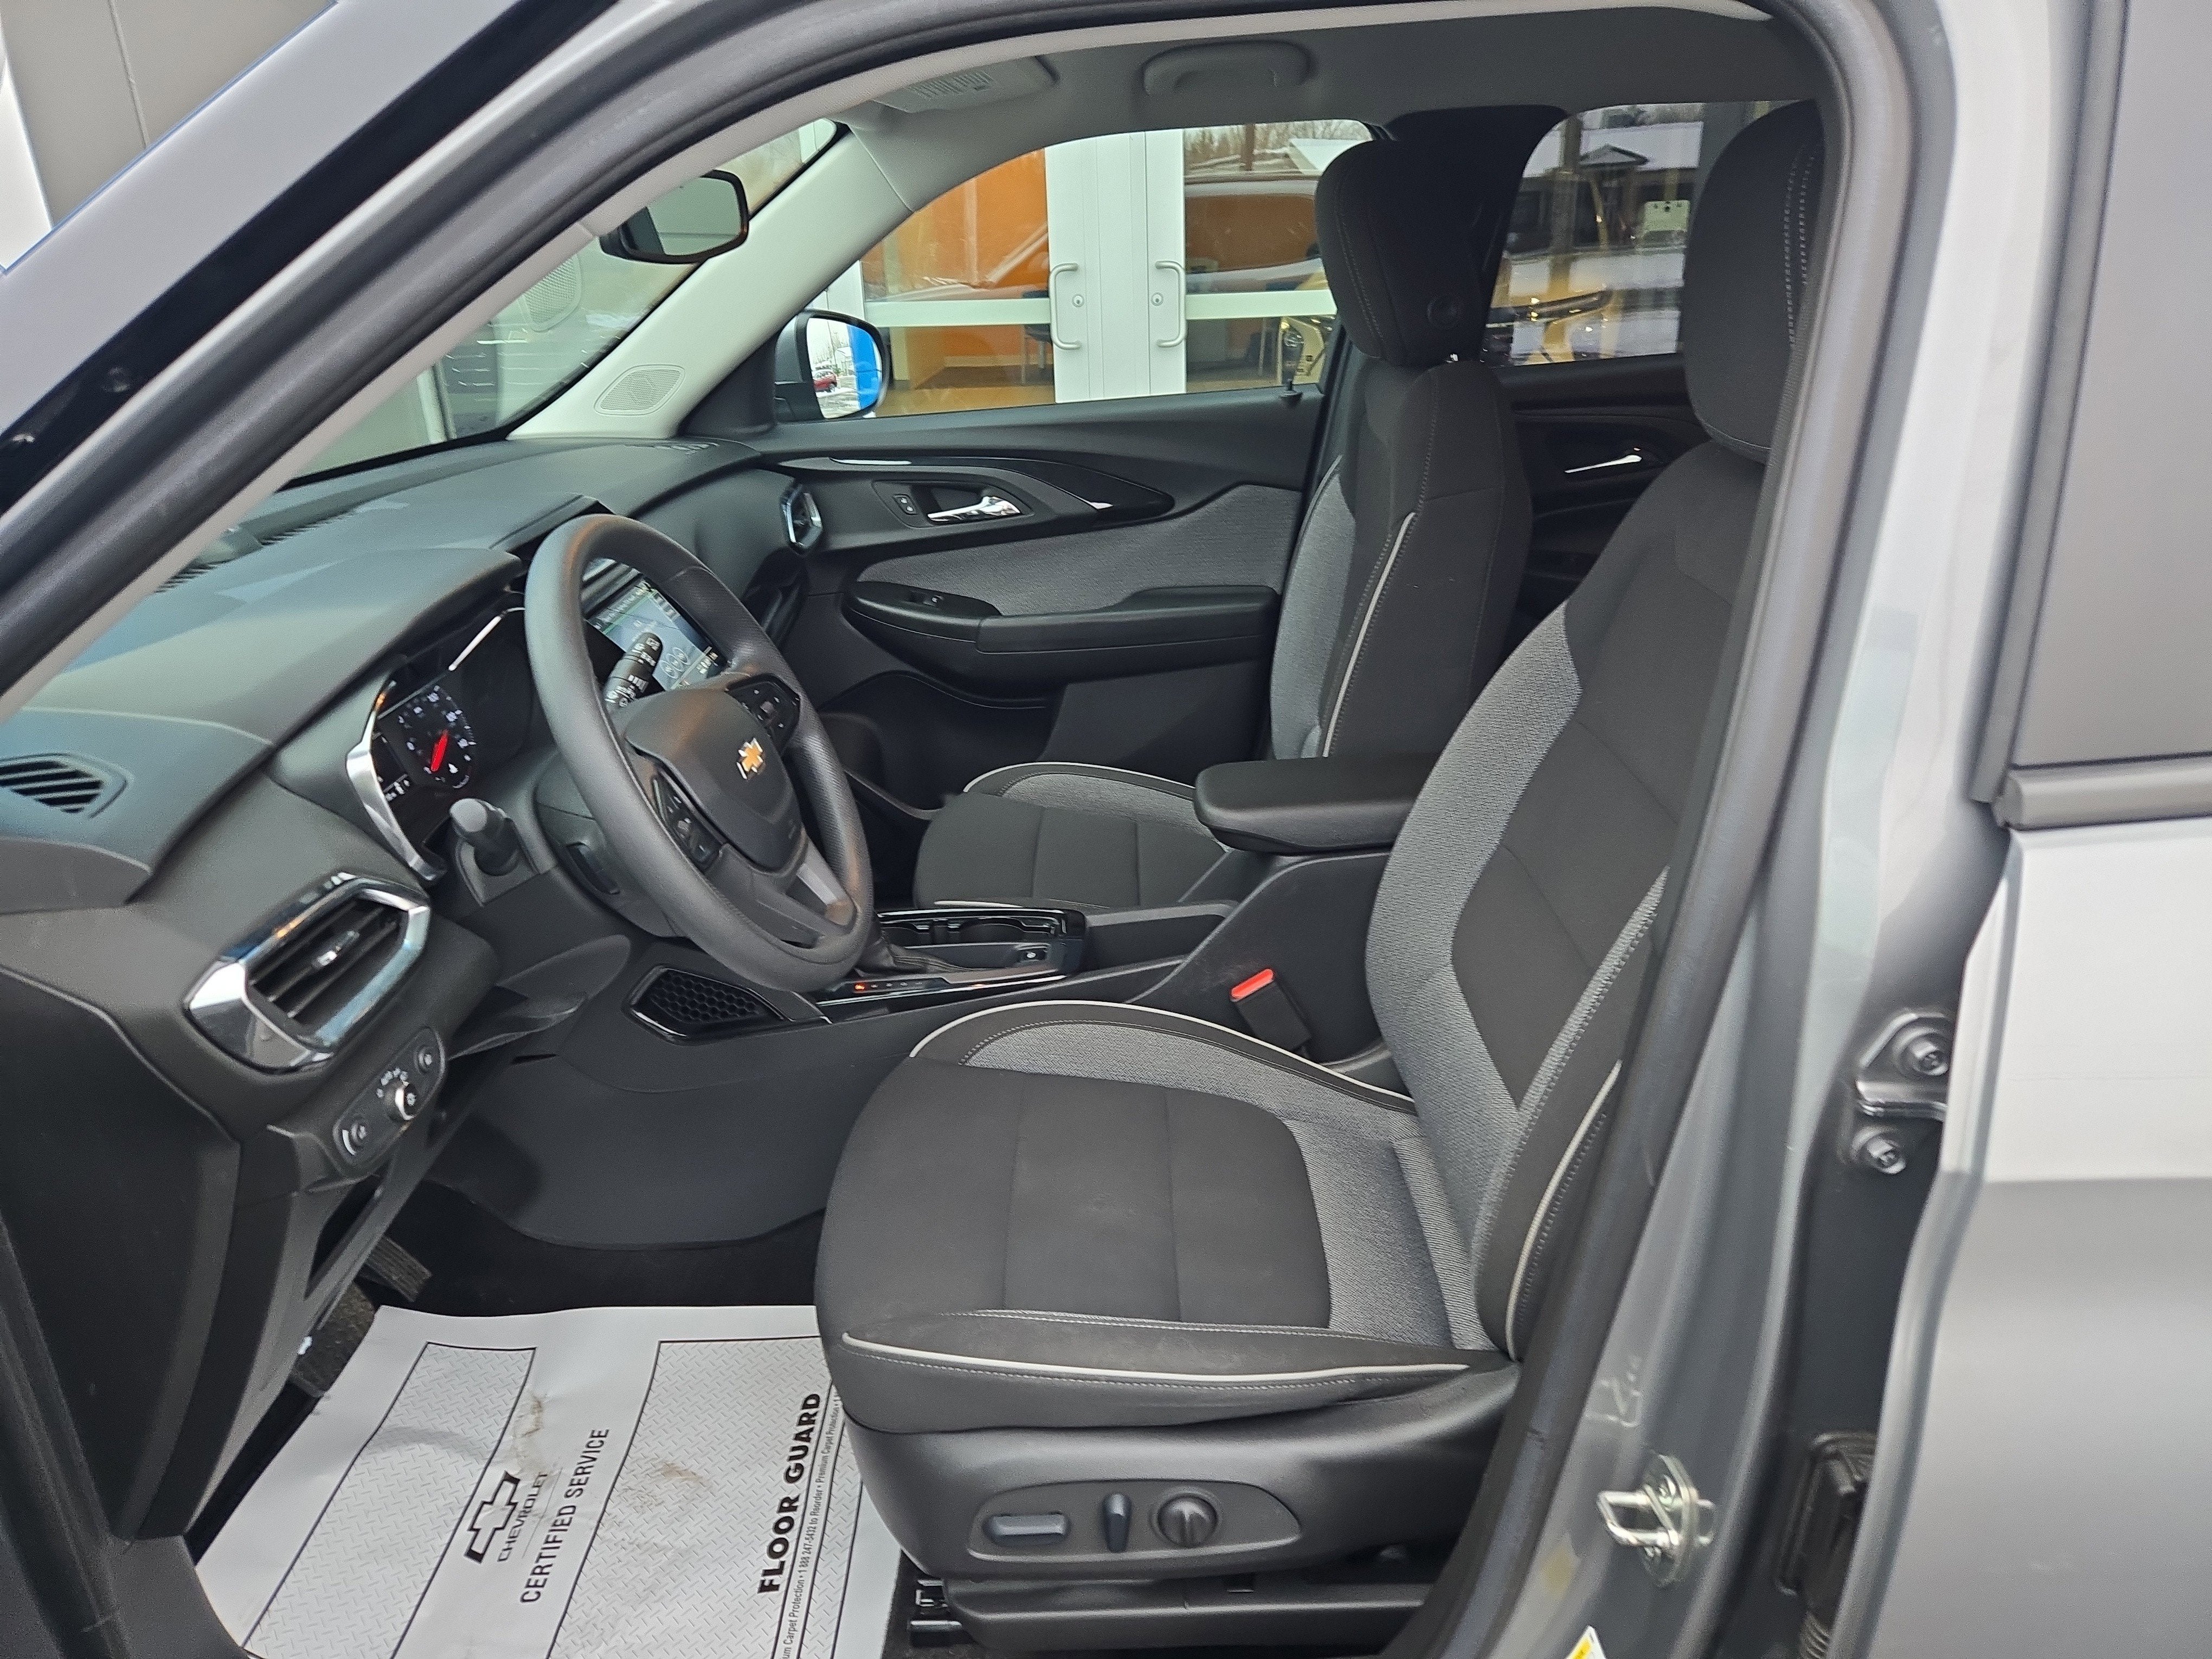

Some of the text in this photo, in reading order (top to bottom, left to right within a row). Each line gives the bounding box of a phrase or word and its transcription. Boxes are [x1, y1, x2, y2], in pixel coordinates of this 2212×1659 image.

[815, 1454, 829, 1483] Premium
[758, 1393, 820, 1593] FLOOR GUARD
[809, 1488, 822, 1516] Reorder
[497, 1472, 548, 1562] CHEVROLET
[520, 1429, 609, 1603] CERTIFIED SERVICE
[809, 1517, 818, 1528] to
[802, 1526, 817, 1555] 247-5432
[789, 1578, 805, 1619] Protection
[783, 1619, 798, 1645] Carpet
